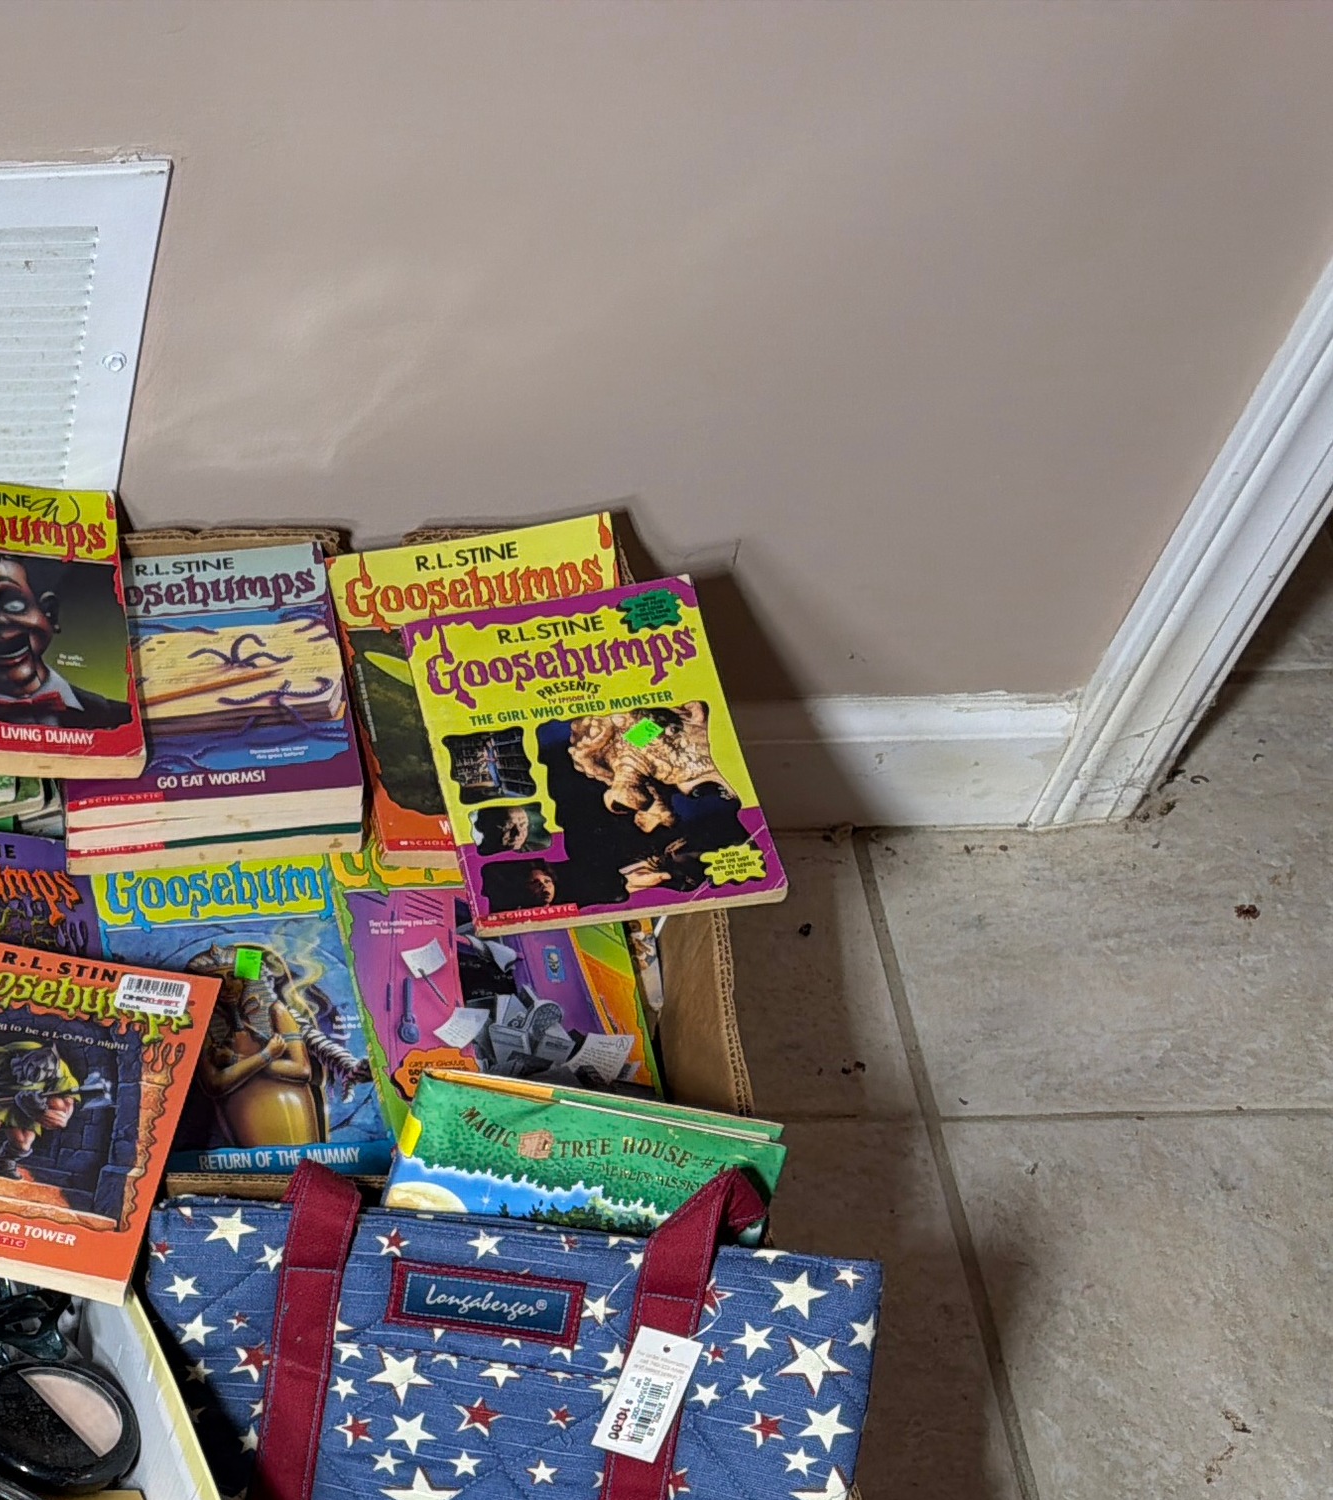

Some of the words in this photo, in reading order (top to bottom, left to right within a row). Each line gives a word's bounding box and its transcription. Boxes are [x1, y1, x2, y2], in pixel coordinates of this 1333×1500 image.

[173, 558, 234, 574] STINE
[454, 542, 518, 566] STINE
[346, 555, 603, 632] Goosebumps
[538, 616, 605, 640] STINE
[427, 627, 697, 707] Goosebumps
[537, 680, 601, 699] PRESENTS
[470, 713, 494, 727] THE
[497, 710, 528, 724] GIRL
[531, 706, 561, 721] WHO
[563, 699, 605, 717] CRIED
[611, 689, 674, 710] MONSTER
[1, 726, 42, 743] LIVING
[45, 729, 95, 746] DUMMY
[157, 775, 178, 788] GO
[181, 774, 204, 788] EAT
[208, 770, 266, 786] WORMS!
[459, 1105, 517, 1149] MAGIC
[558, 1137, 613, 1159] TREE
[622, 1136, 693, 1169] HOUSE
[198, 1153, 253, 1171] RETURN
[255, 1152, 271, 1168] OF
[275, 1150, 302, 1167] THE
[304, 1147, 361, 1166] MUMMY
[24, 1223, 76, 1246] TOWER
